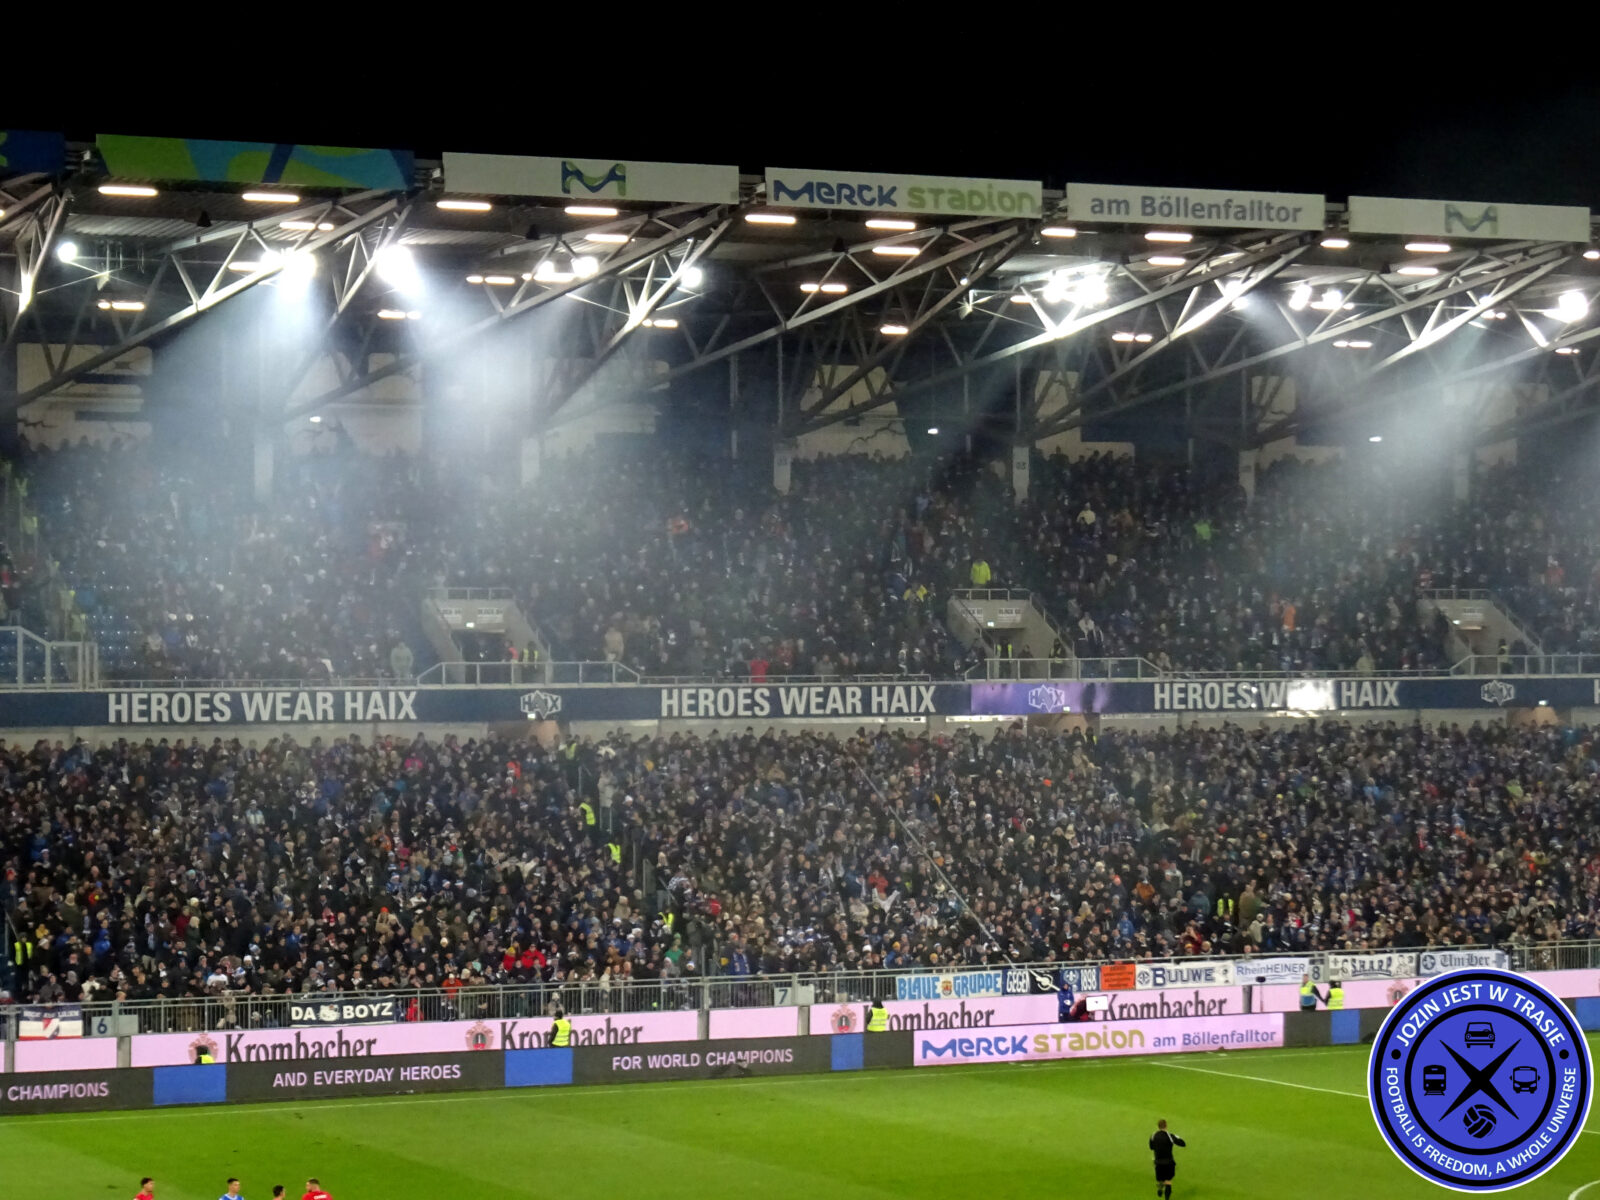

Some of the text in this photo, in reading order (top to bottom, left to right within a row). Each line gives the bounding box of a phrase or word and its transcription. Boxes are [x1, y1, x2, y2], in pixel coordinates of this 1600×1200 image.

[1091, 194, 1303, 224] am Böllenfalltor
[661, 685, 937, 718] HEROES WEAR HAIX
[1153, 682, 1252, 711] HEROES
[1341, 680, 1399, 708] HAIX
[108, 690, 417, 724] HEROES WEAR HAIX
[1081, 968, 1097, 991] 1898
[1236, 962, 1306, 977] RheinHEINER
[1312, 965, 1321, 981] 8
[778, 988, 789, 1005] 7
[897, 972, 1002, 1000] BLAUE GRUPPE
[290, 1002, 393, 1021] DA BOYZ
[97, 1018, 108, 1035] 6
[225, 1029, 377, 1063] Krombacher
[1153, 1034, 1177, 1048] am
[1182, 1029, 1277, 1047] Böllenfalltor
[612, 1048, 794, 1071] FOR WORLD CHAMPIONS
[273, 1064, 461, 1088] AND EVERYDAY HEROES
[7, 1082, 110, 1101] CHAMPIONS
